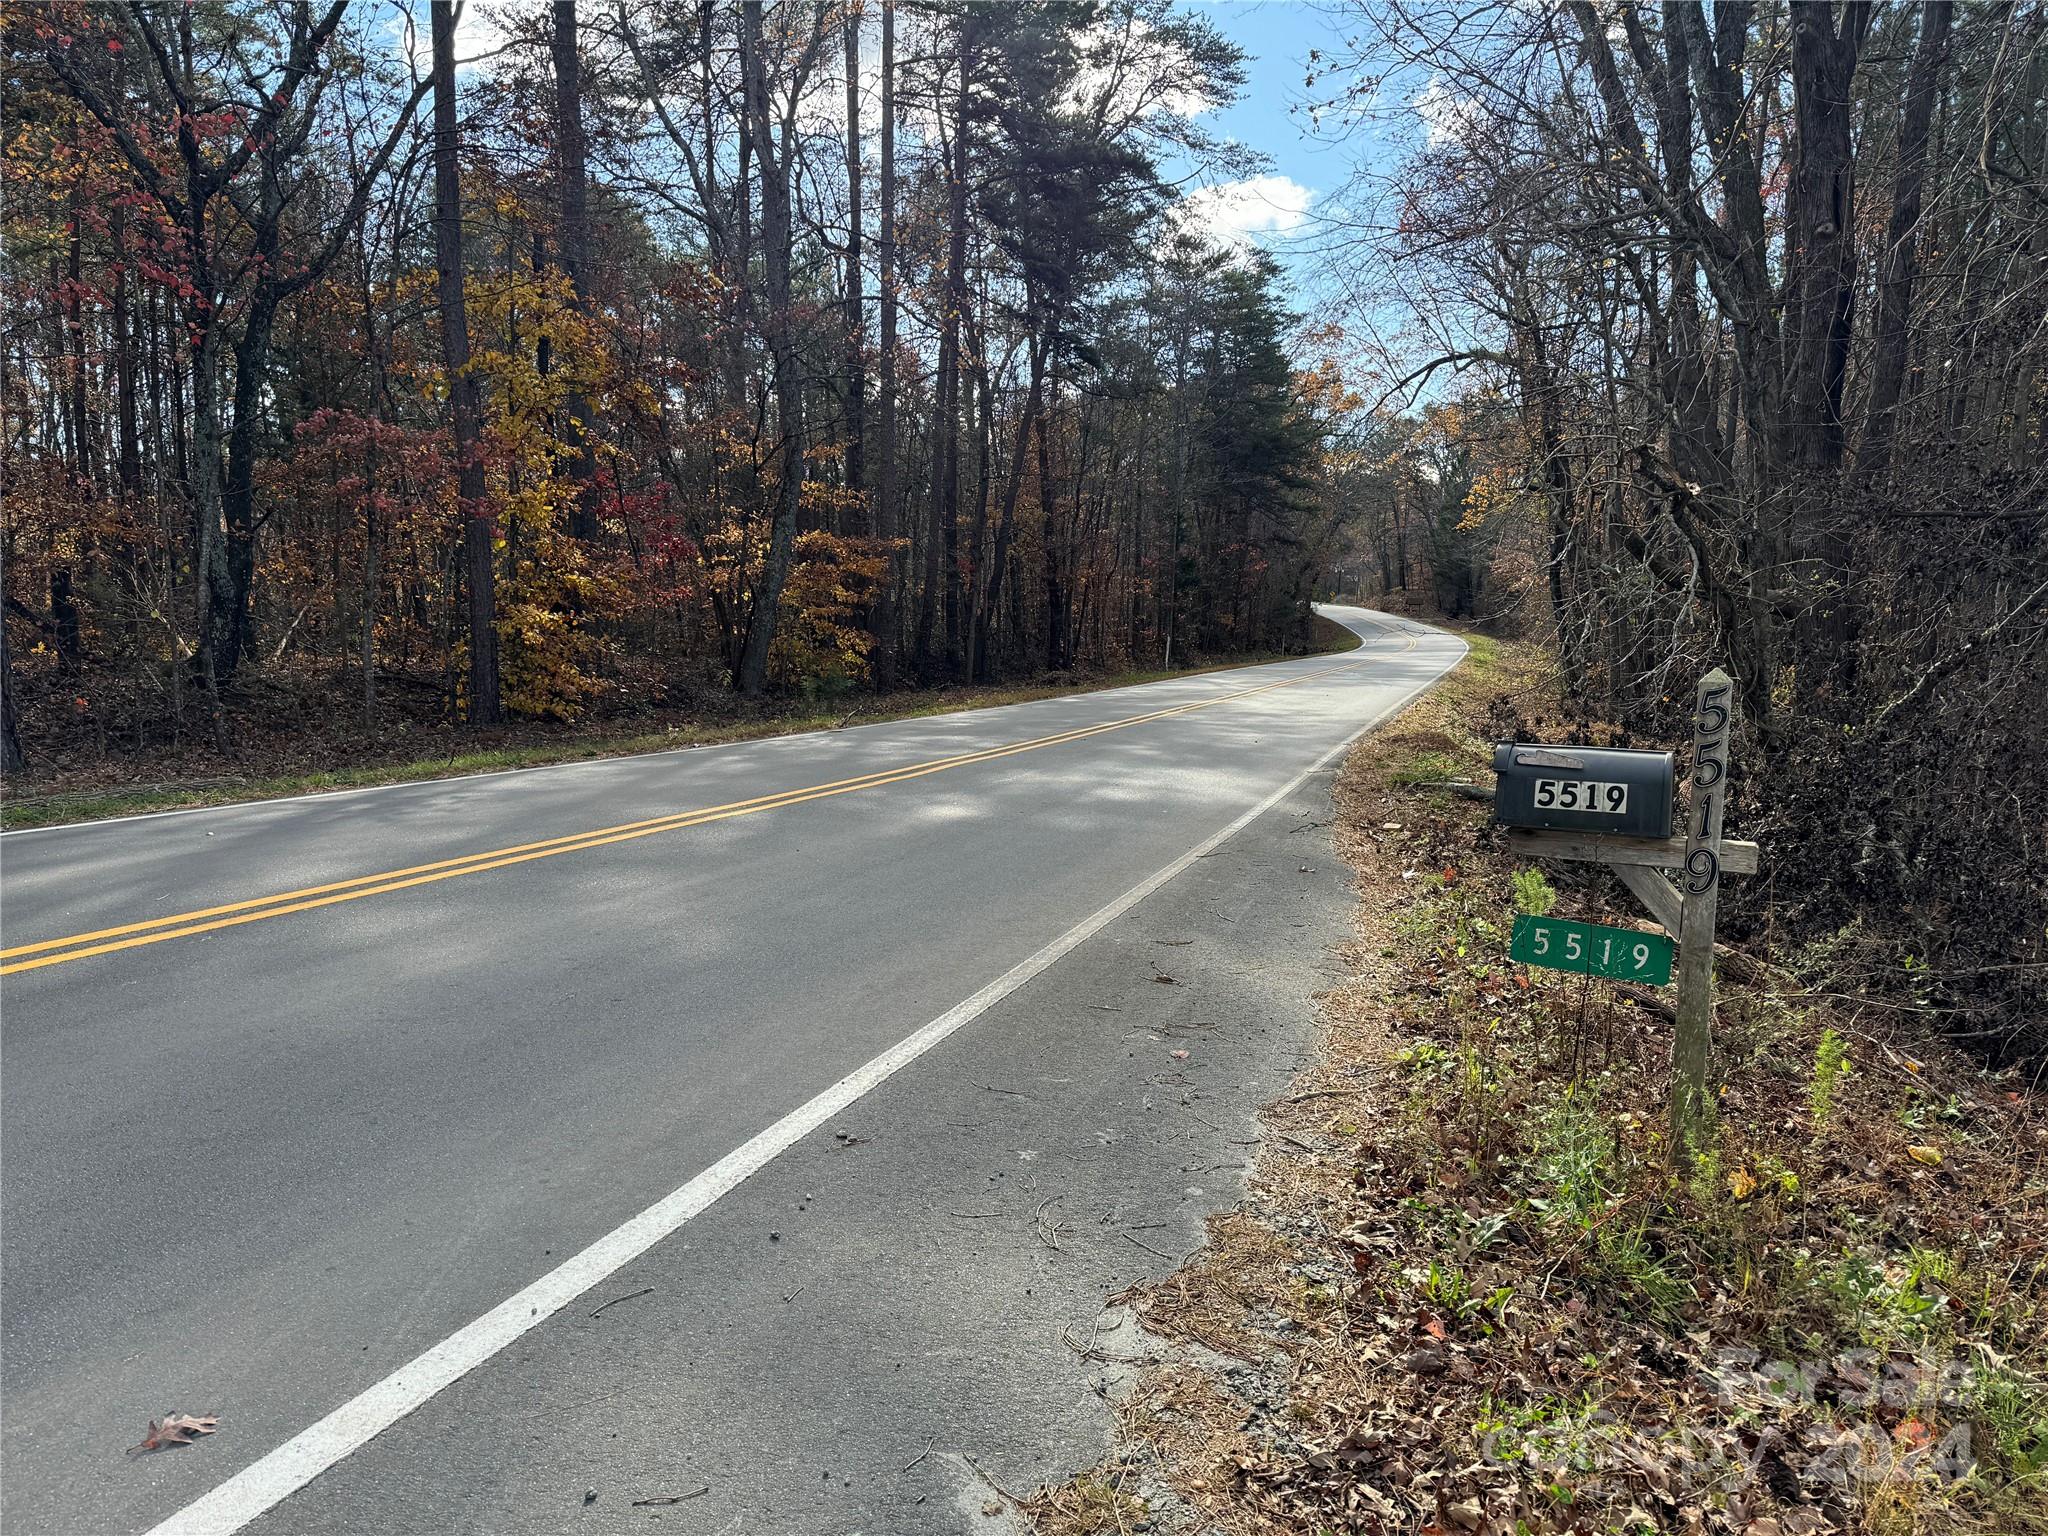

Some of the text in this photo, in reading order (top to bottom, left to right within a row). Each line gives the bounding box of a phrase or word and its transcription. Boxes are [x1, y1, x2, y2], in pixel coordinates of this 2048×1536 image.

[1536, 781, 1626, 812] 5519
[1685, 685, 1730, 895] 5519
[1533, 928, 1650, 970] 5519
